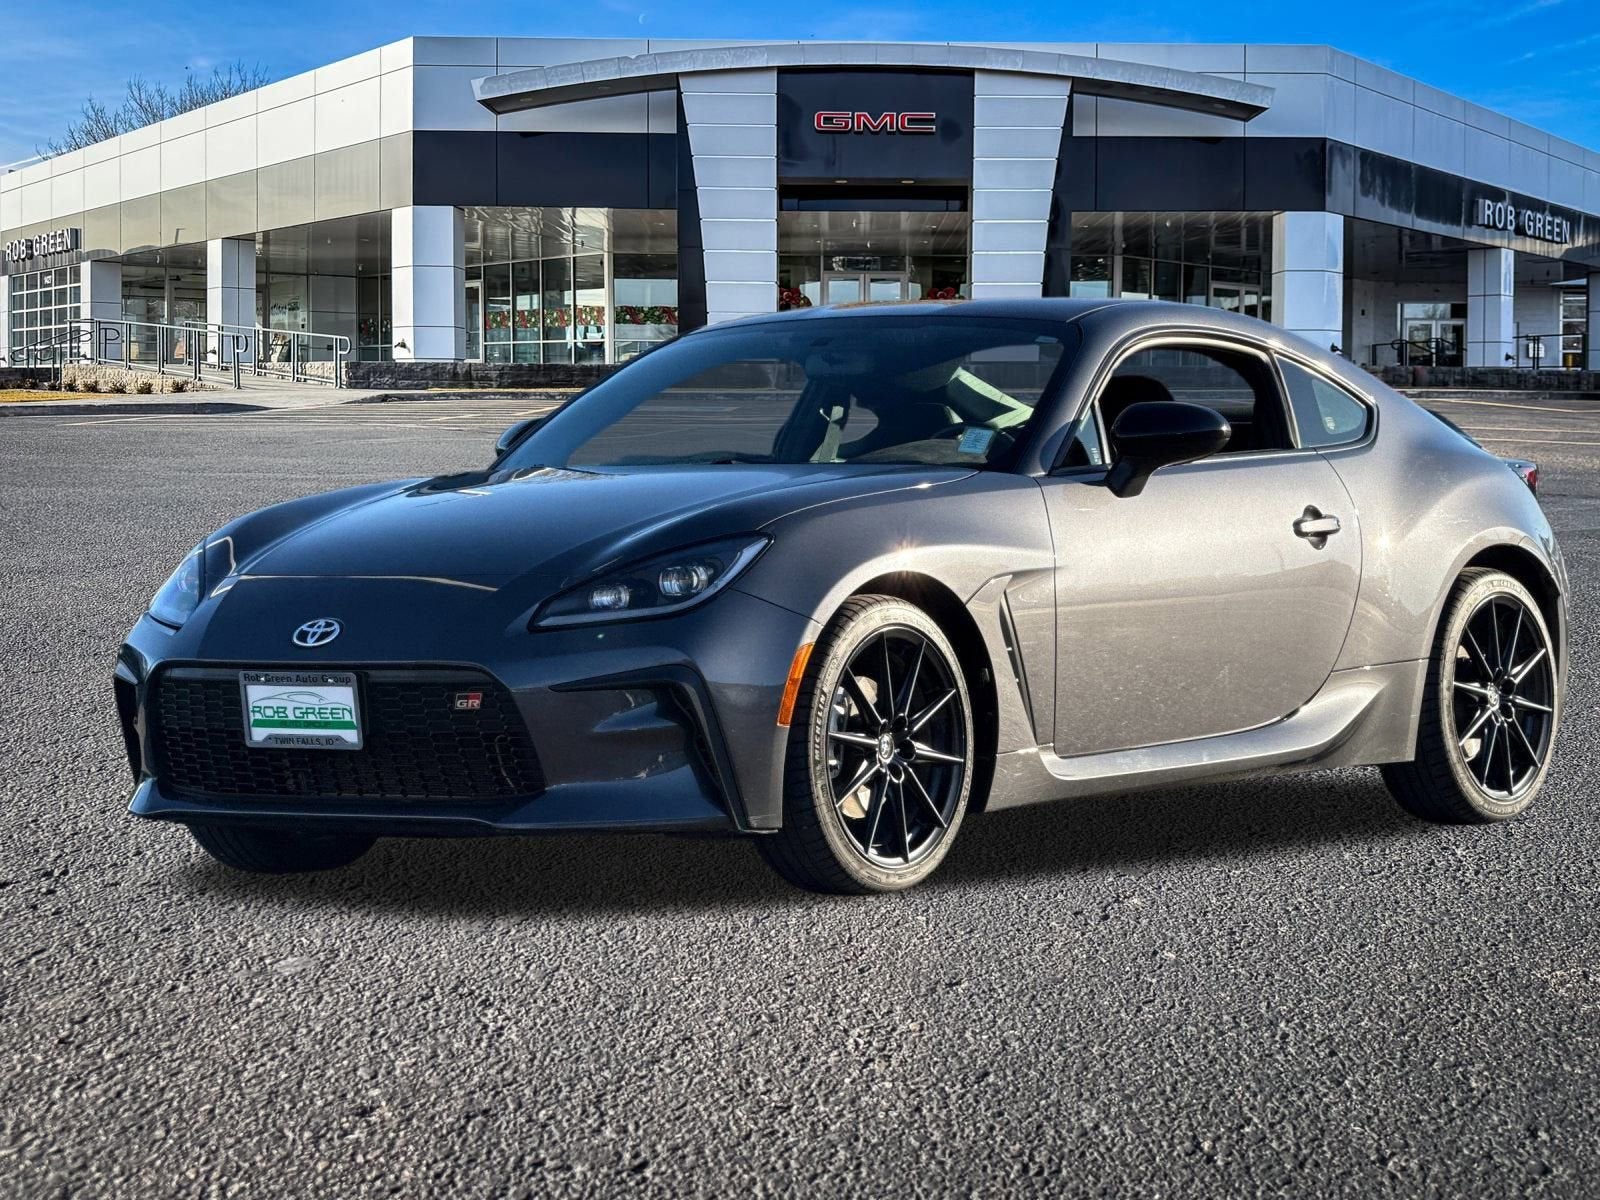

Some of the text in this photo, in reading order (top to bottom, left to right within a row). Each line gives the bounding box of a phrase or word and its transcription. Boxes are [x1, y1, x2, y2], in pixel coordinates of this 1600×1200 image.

[814, 111, 936, 132] GMC
[1484, 199, 1570, 243] ROB GREEN
[6, 228, 71, 261] ROB GREEN
[244, 673, 261, 682] Rob
[264, 674, 293, 683] Green
[295, 674, 318, 683] Auto
[251, 705, 353, 720] ROB GREEN
[456, 699, 480, 709] GR
[814, 692, 827, 760] MICHELIN
[274, 736, 295, 745] TWIN
[296, 737, 324, 746] FALLS,
